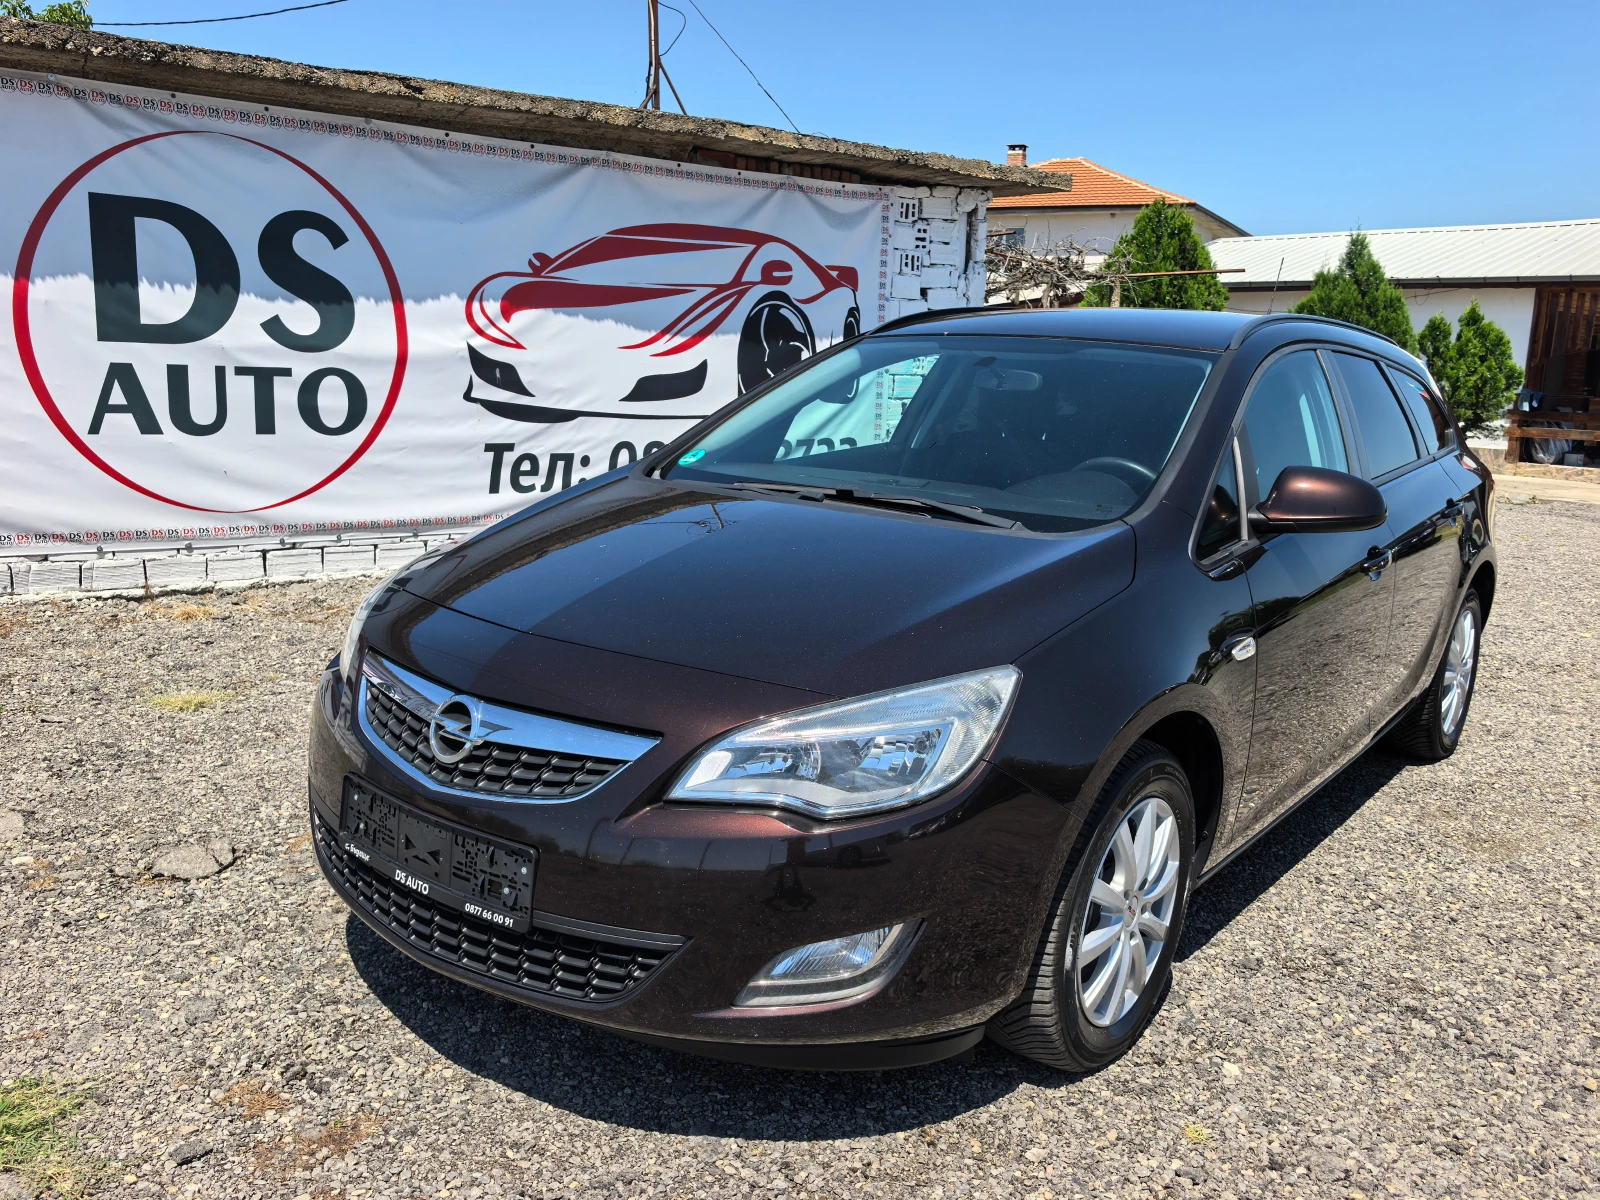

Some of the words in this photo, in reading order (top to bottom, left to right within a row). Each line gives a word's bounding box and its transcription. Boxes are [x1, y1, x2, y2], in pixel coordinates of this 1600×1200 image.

[1, 78, 14, 86] DS
[20, 80, 33, 88] DS
[88, 192, 355, 353] DS
[88, 362, 368, 436] AUTO
[484, 443, 590, 494] Тел:
[395, 870, 406, 883] DS
[406, 876, 429, 894] AUTO
[465, 903, 482, 916] 0877
[483, 910, 492, 920] 66
[494, 914, 503, 923] 00
[505, 917, 513, 927] 91
